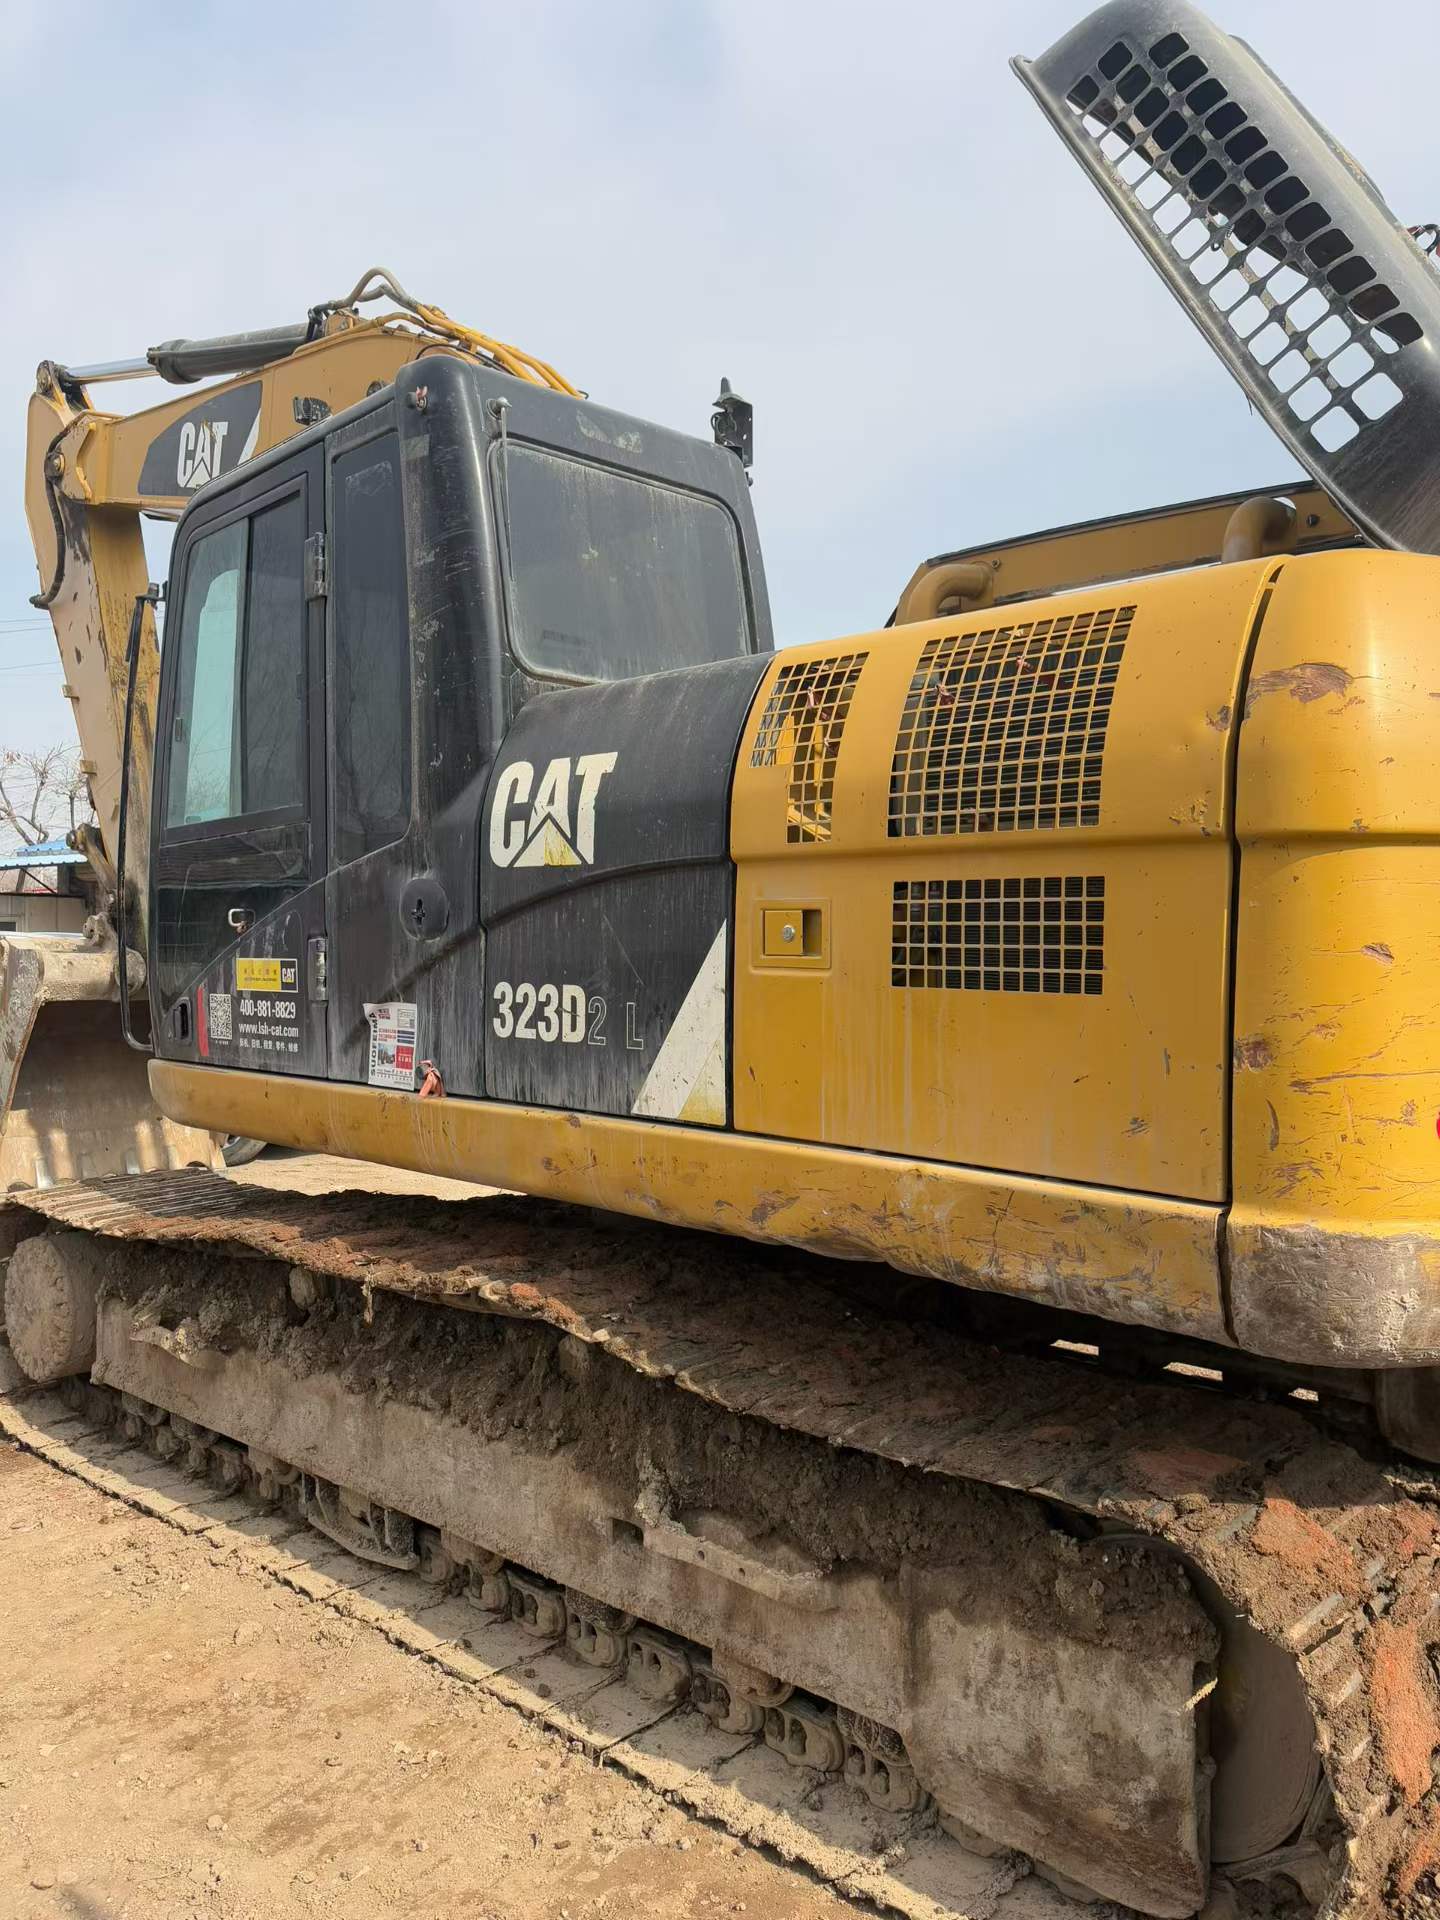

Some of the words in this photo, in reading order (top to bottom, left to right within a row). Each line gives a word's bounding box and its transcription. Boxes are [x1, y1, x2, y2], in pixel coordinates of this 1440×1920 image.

[177, 421, 229, 488] CAT
[489, 751, 618, 868] CAT
[282, 967, 295, 983] CAT
[239, 999, 296, 1019] 400-881-8829
[626, 1002, 644, 1050] L
[238, 1022, 299, 1038] www.lsh-cat.com
